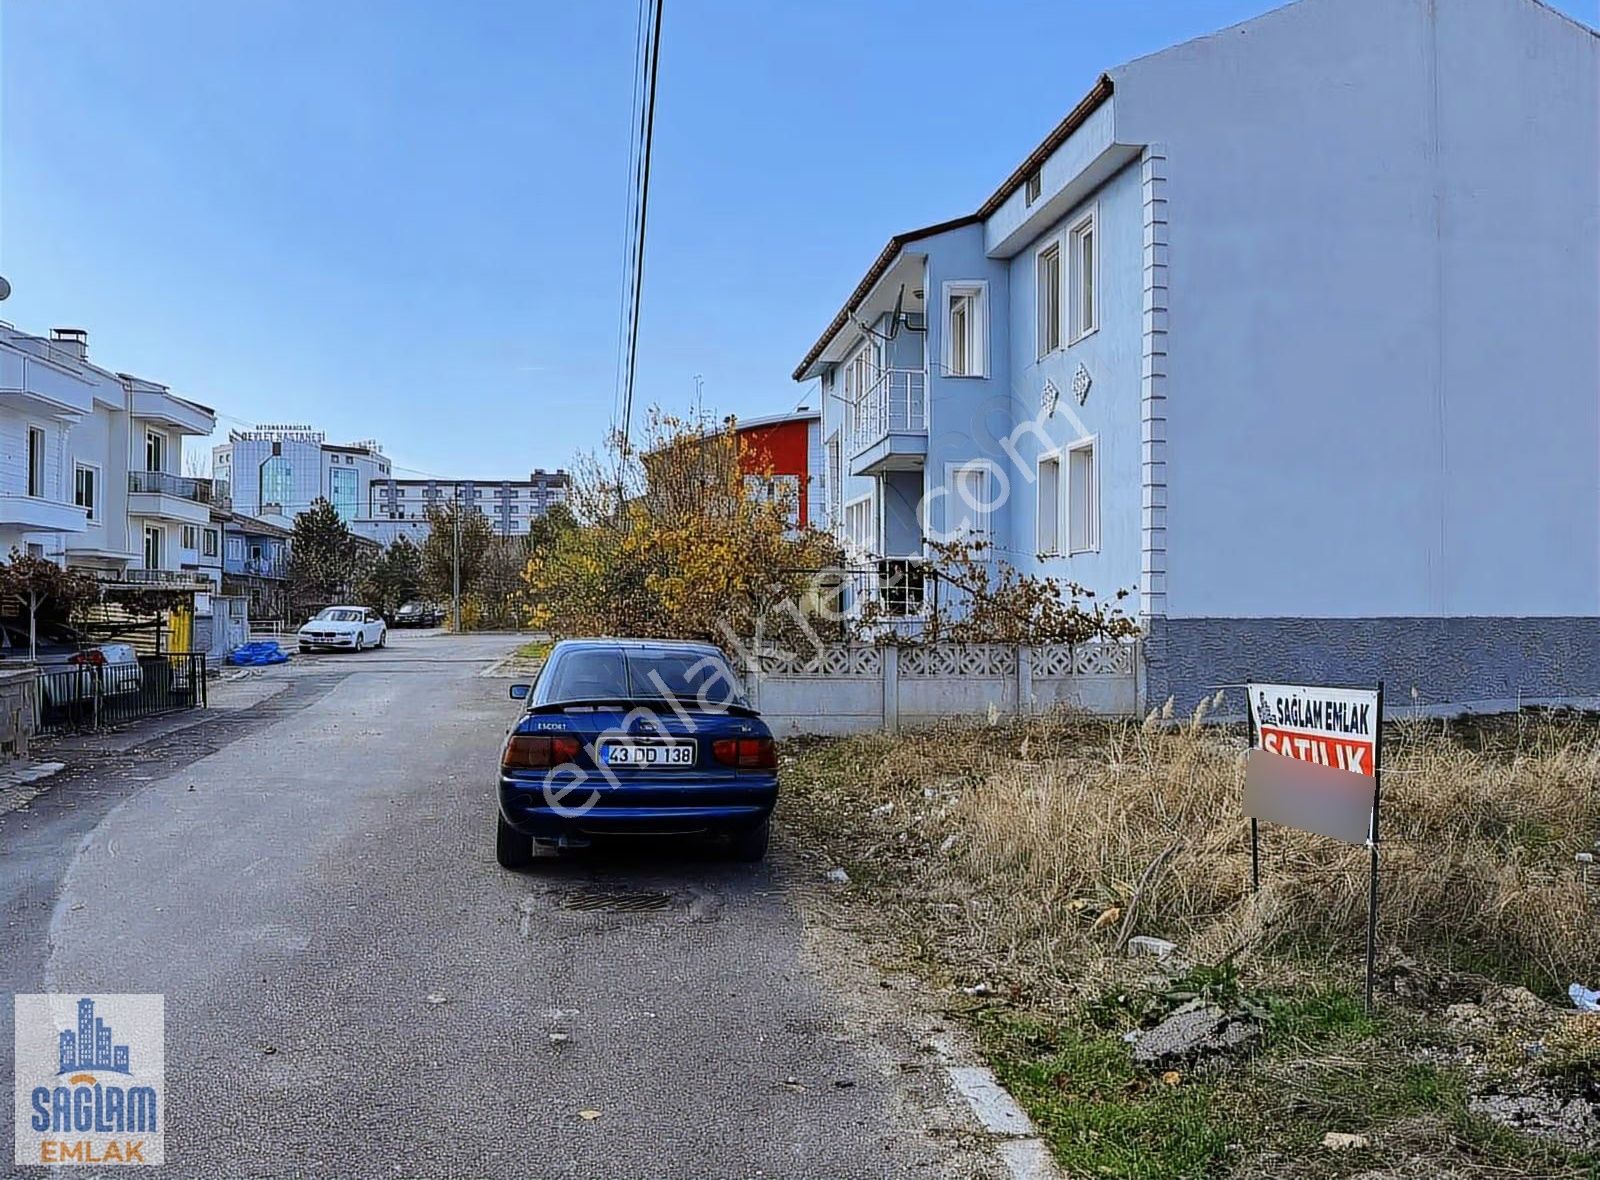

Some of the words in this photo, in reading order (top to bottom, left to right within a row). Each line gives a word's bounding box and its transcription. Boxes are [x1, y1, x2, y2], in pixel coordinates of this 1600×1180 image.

[1276, 694, 1323, 729] SAĞLAM
[1325, 701, 1370, 735] EMLAK
[609, 747, 629, 762] 43
[634, 747, 657, 762] DD
[665, 747, 690, 762] 138
